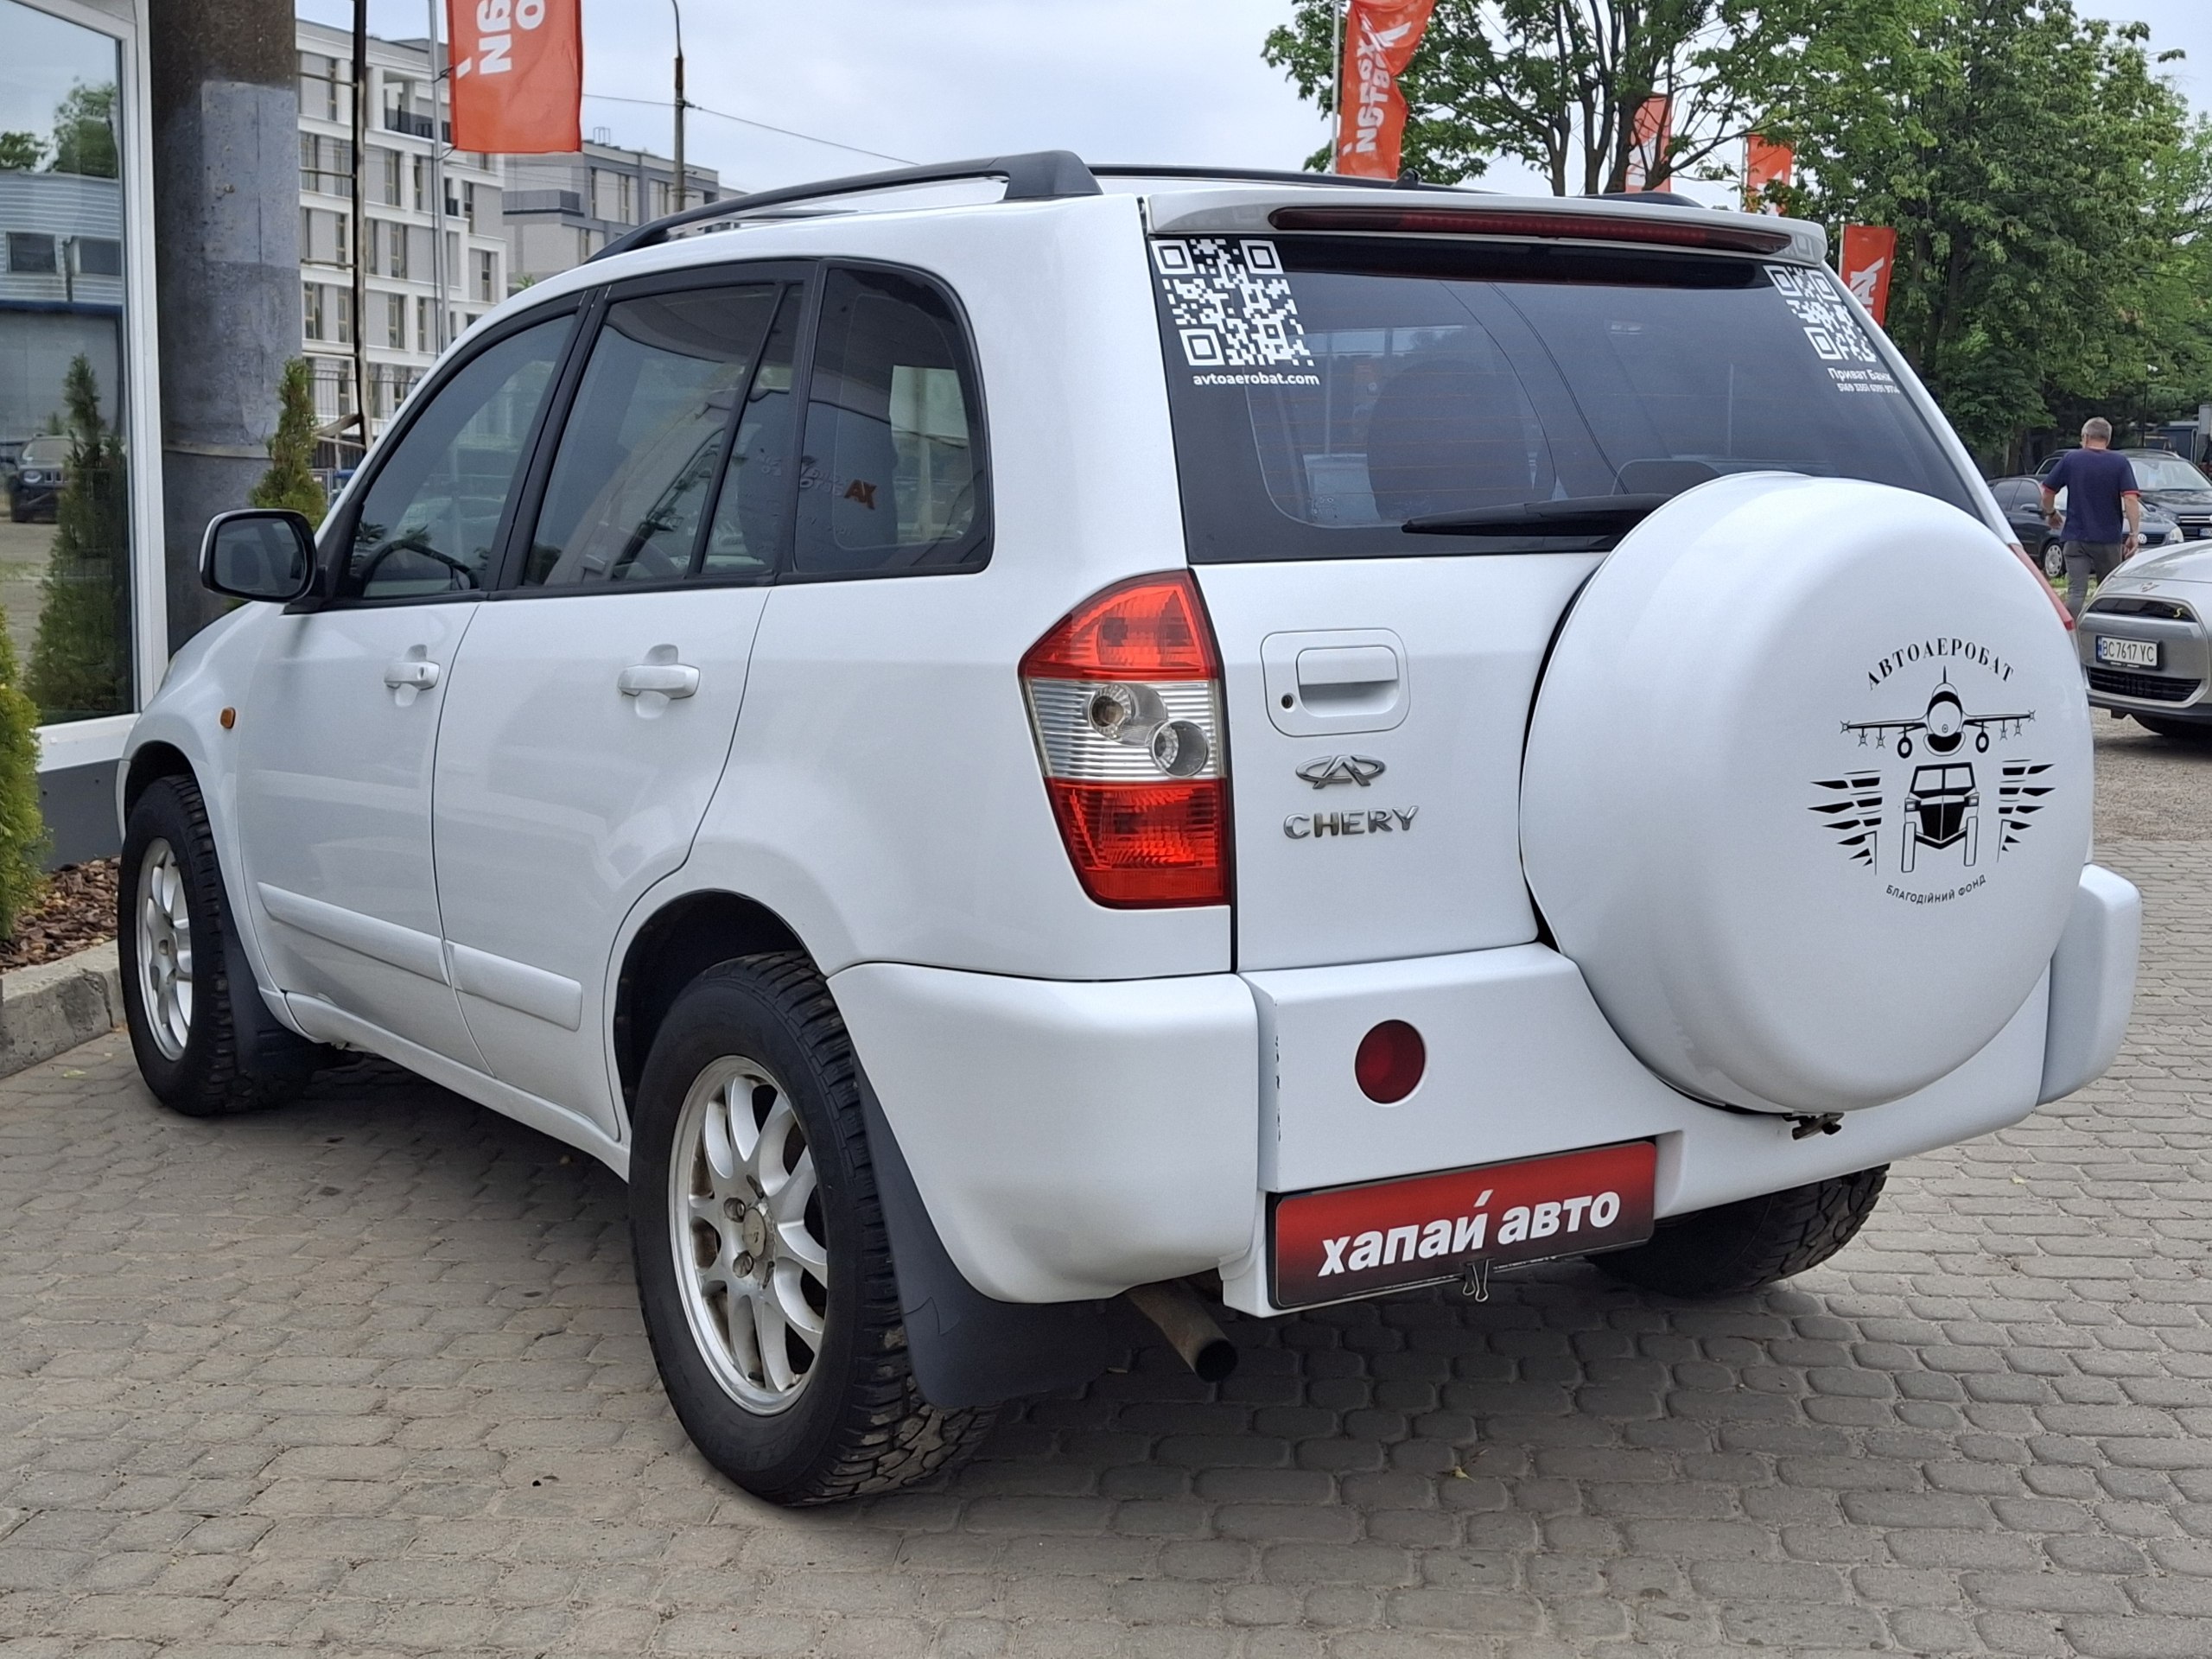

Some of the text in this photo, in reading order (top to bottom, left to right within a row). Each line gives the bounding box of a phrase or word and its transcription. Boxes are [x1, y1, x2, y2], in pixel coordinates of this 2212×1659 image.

[1192, 373, 1320, 385] avtoaerobat.com
[1827, 367, 1893, 382] Приват Банк
[1867, 638, 2014, 690] АВТОАЕРОБАТ
[2102, 640, 2154, 662] BC 7617 YC
[1284, 806, 1419, 839] CHERY
[1886, 874, 1986, 905] БЛАГОДІЙНИЙ ФОНД
[1319, 1190, 1620, 1277] хапай авто
